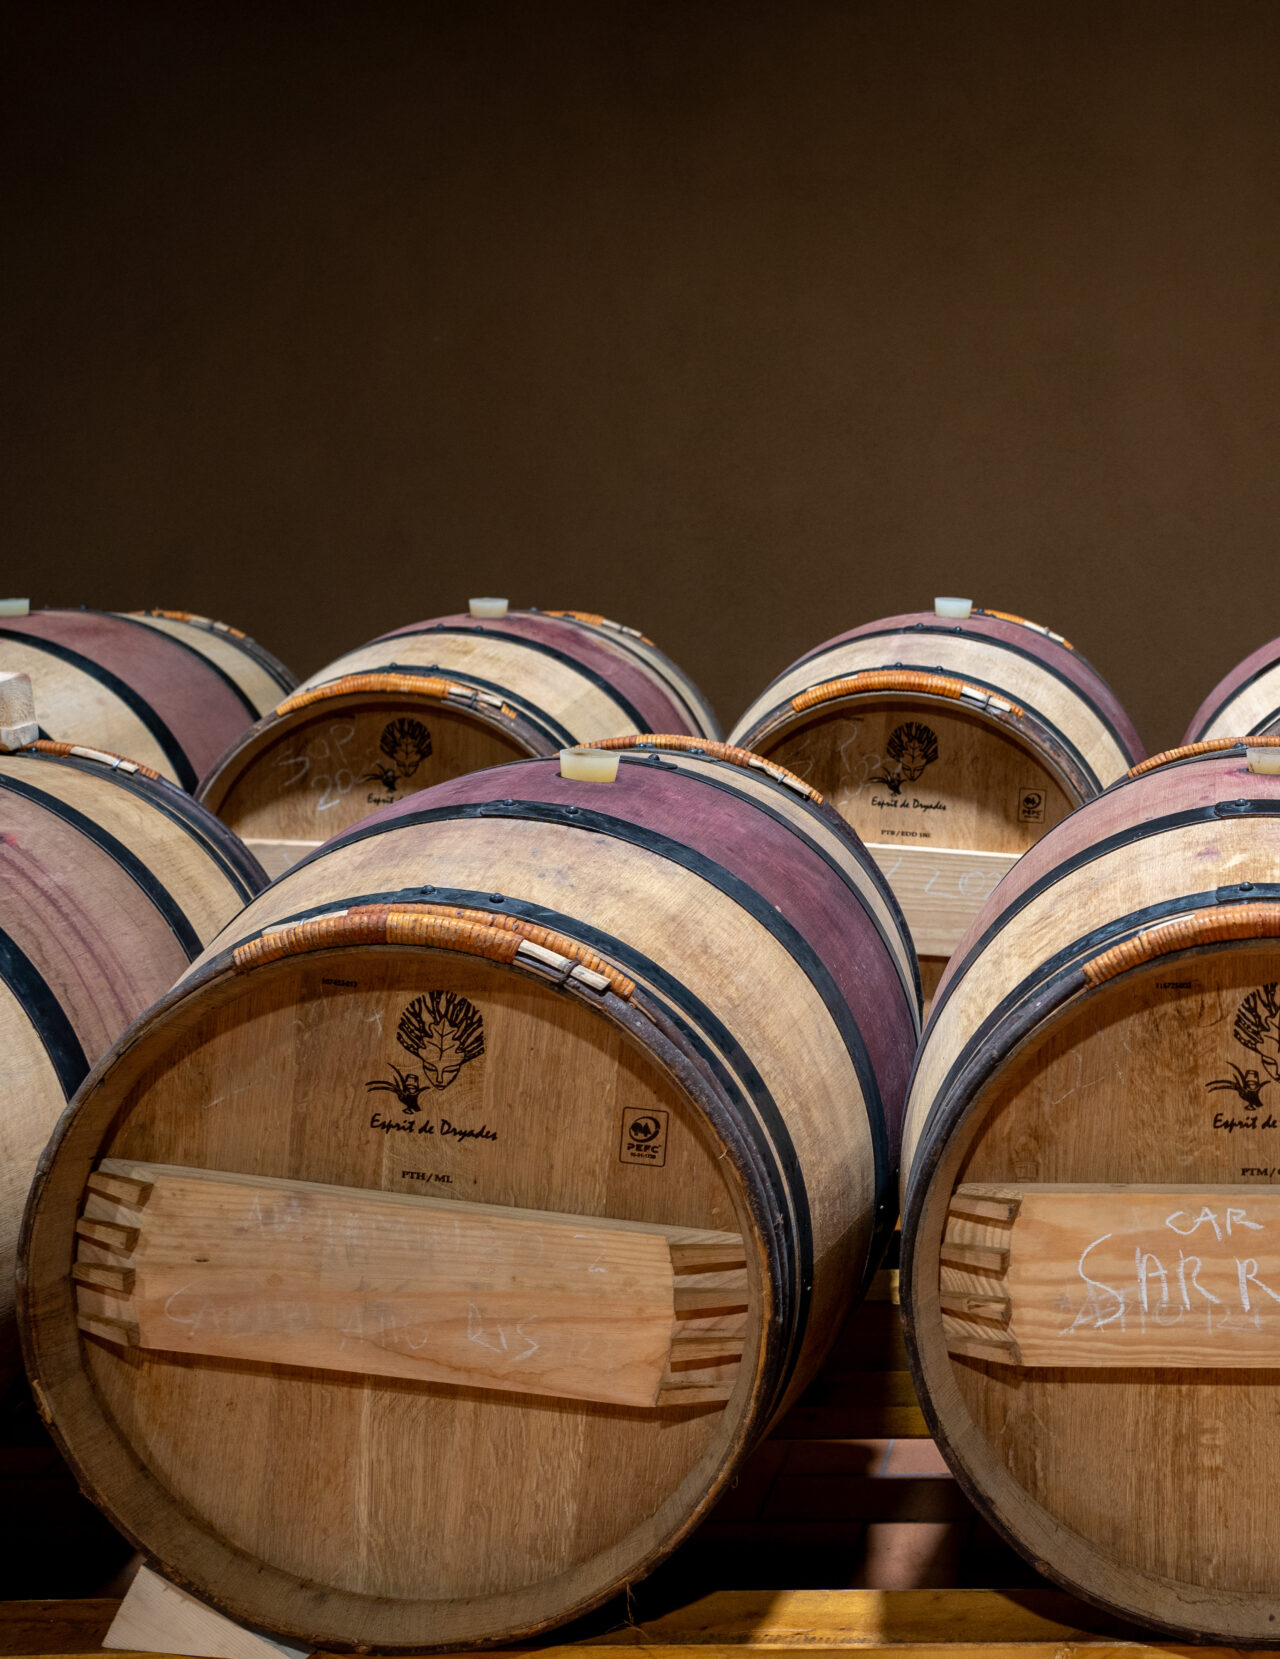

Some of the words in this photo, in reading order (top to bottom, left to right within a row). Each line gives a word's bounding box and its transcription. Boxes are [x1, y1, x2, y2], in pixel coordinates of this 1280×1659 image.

[872, 796, 898, 810] Esprit
[899, 799, 910, 808] de
[912, 798, 947, 813] Dryades
[370, 1112, 415, 1135] Esprit
[418, 1120, 435, 1135] de
[440, 1118, 498, 1143] Dryades
[1212, 1112, 1259, 1134] Esprit
[1261, 1114, 1277, 1129] de
[627, 1143, 660, 1154] PEFC
[1165, 1207, 1264, 1242] CAR
